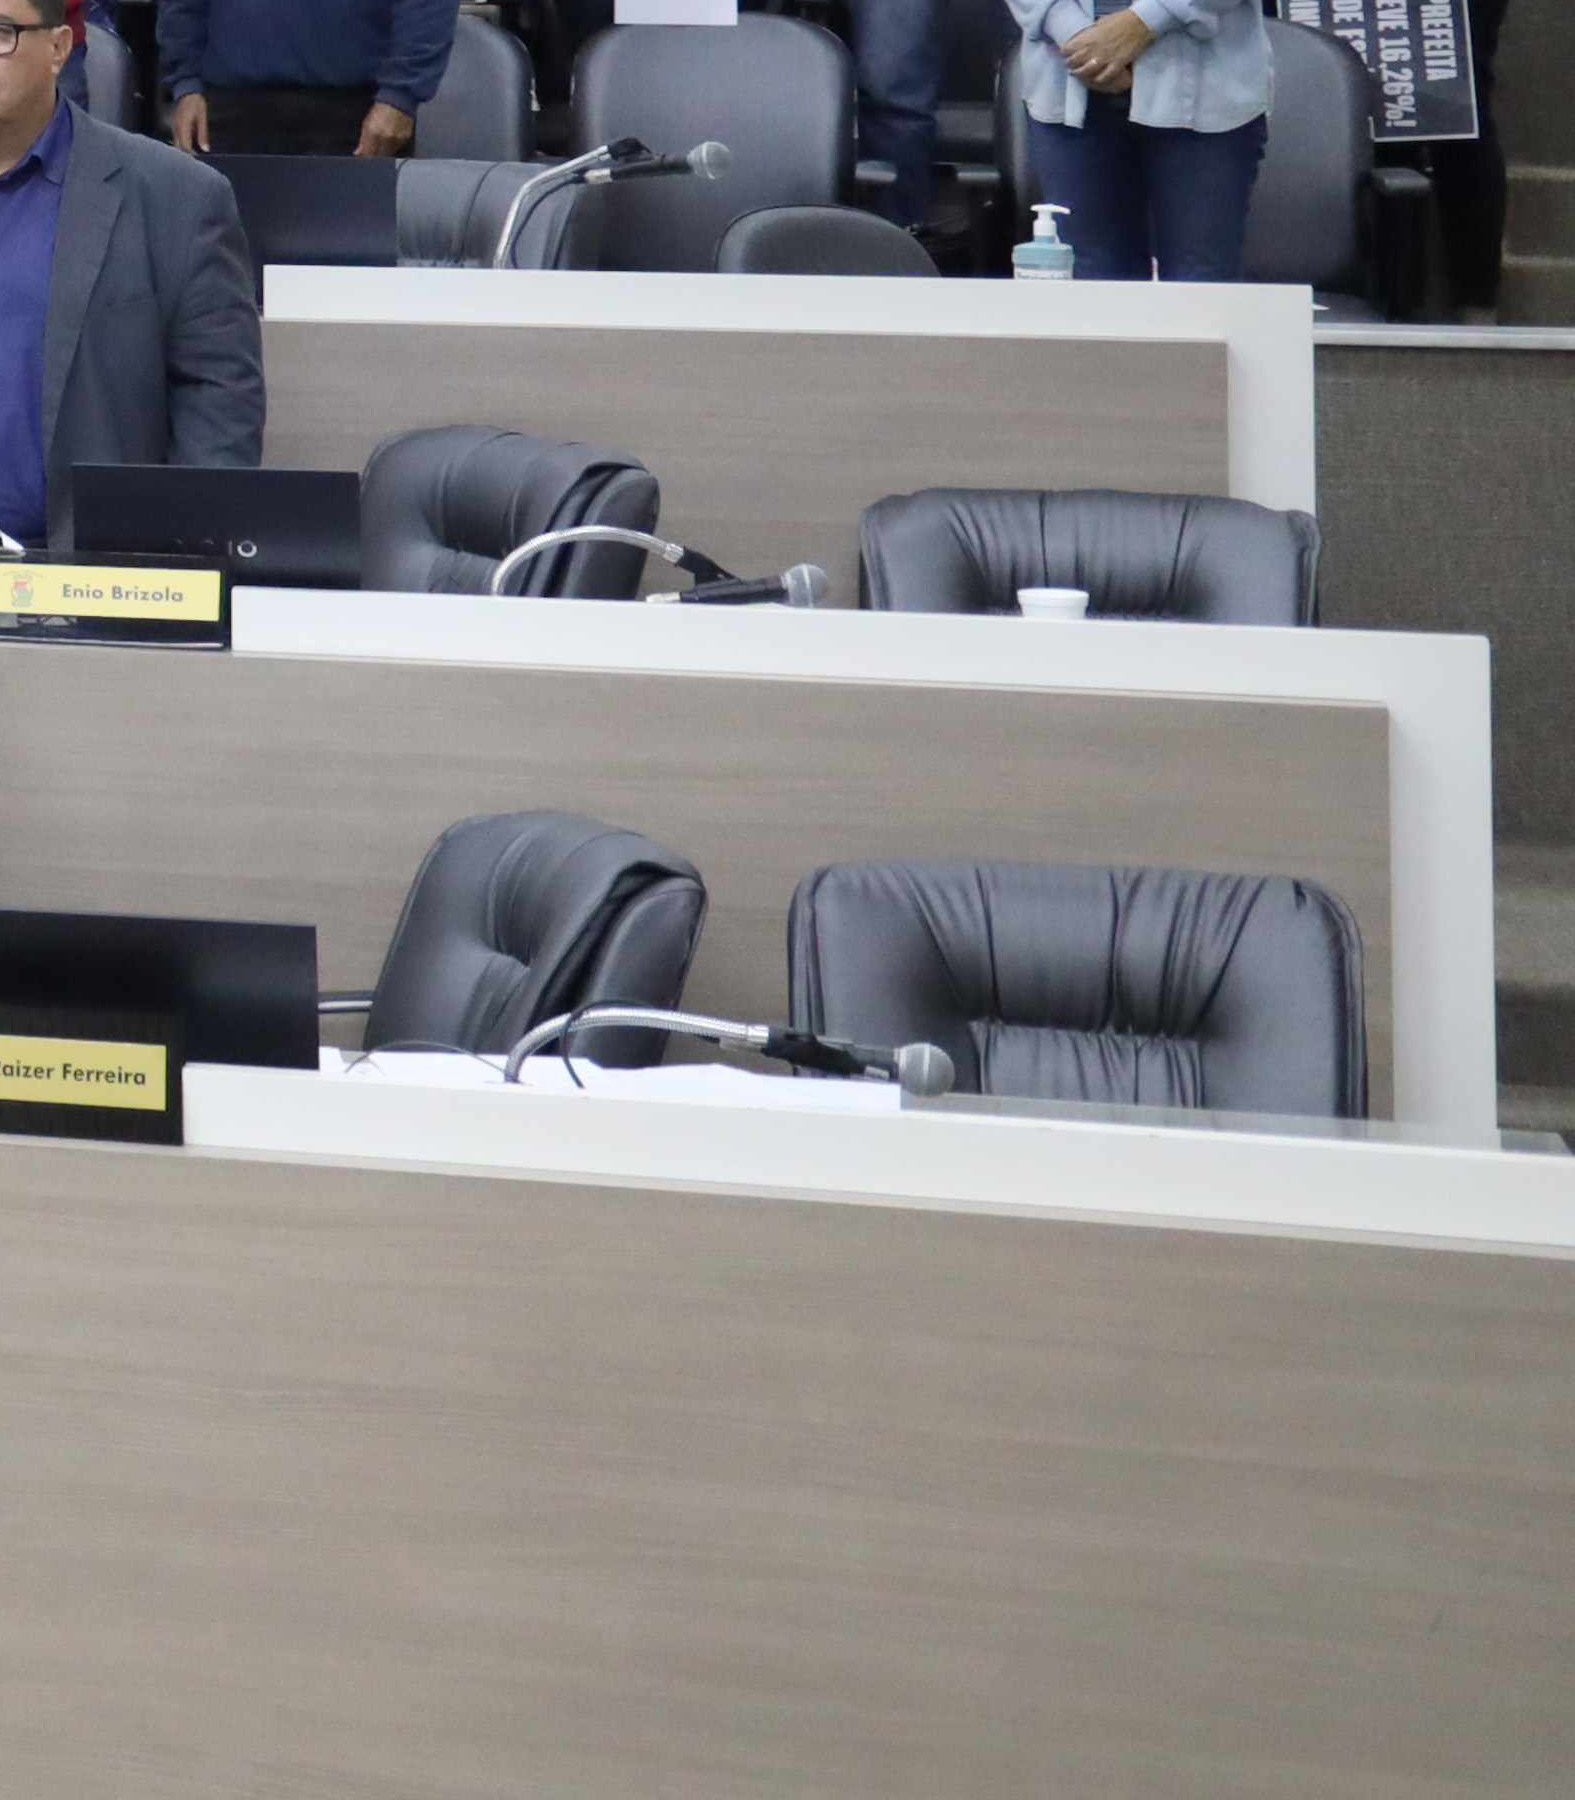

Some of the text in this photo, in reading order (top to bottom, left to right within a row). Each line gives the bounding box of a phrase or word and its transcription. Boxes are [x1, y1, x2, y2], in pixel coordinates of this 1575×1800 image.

[62, 583, 183, 602] Enio Brizola
[62, 1063, 146, 1086] Ferreira
